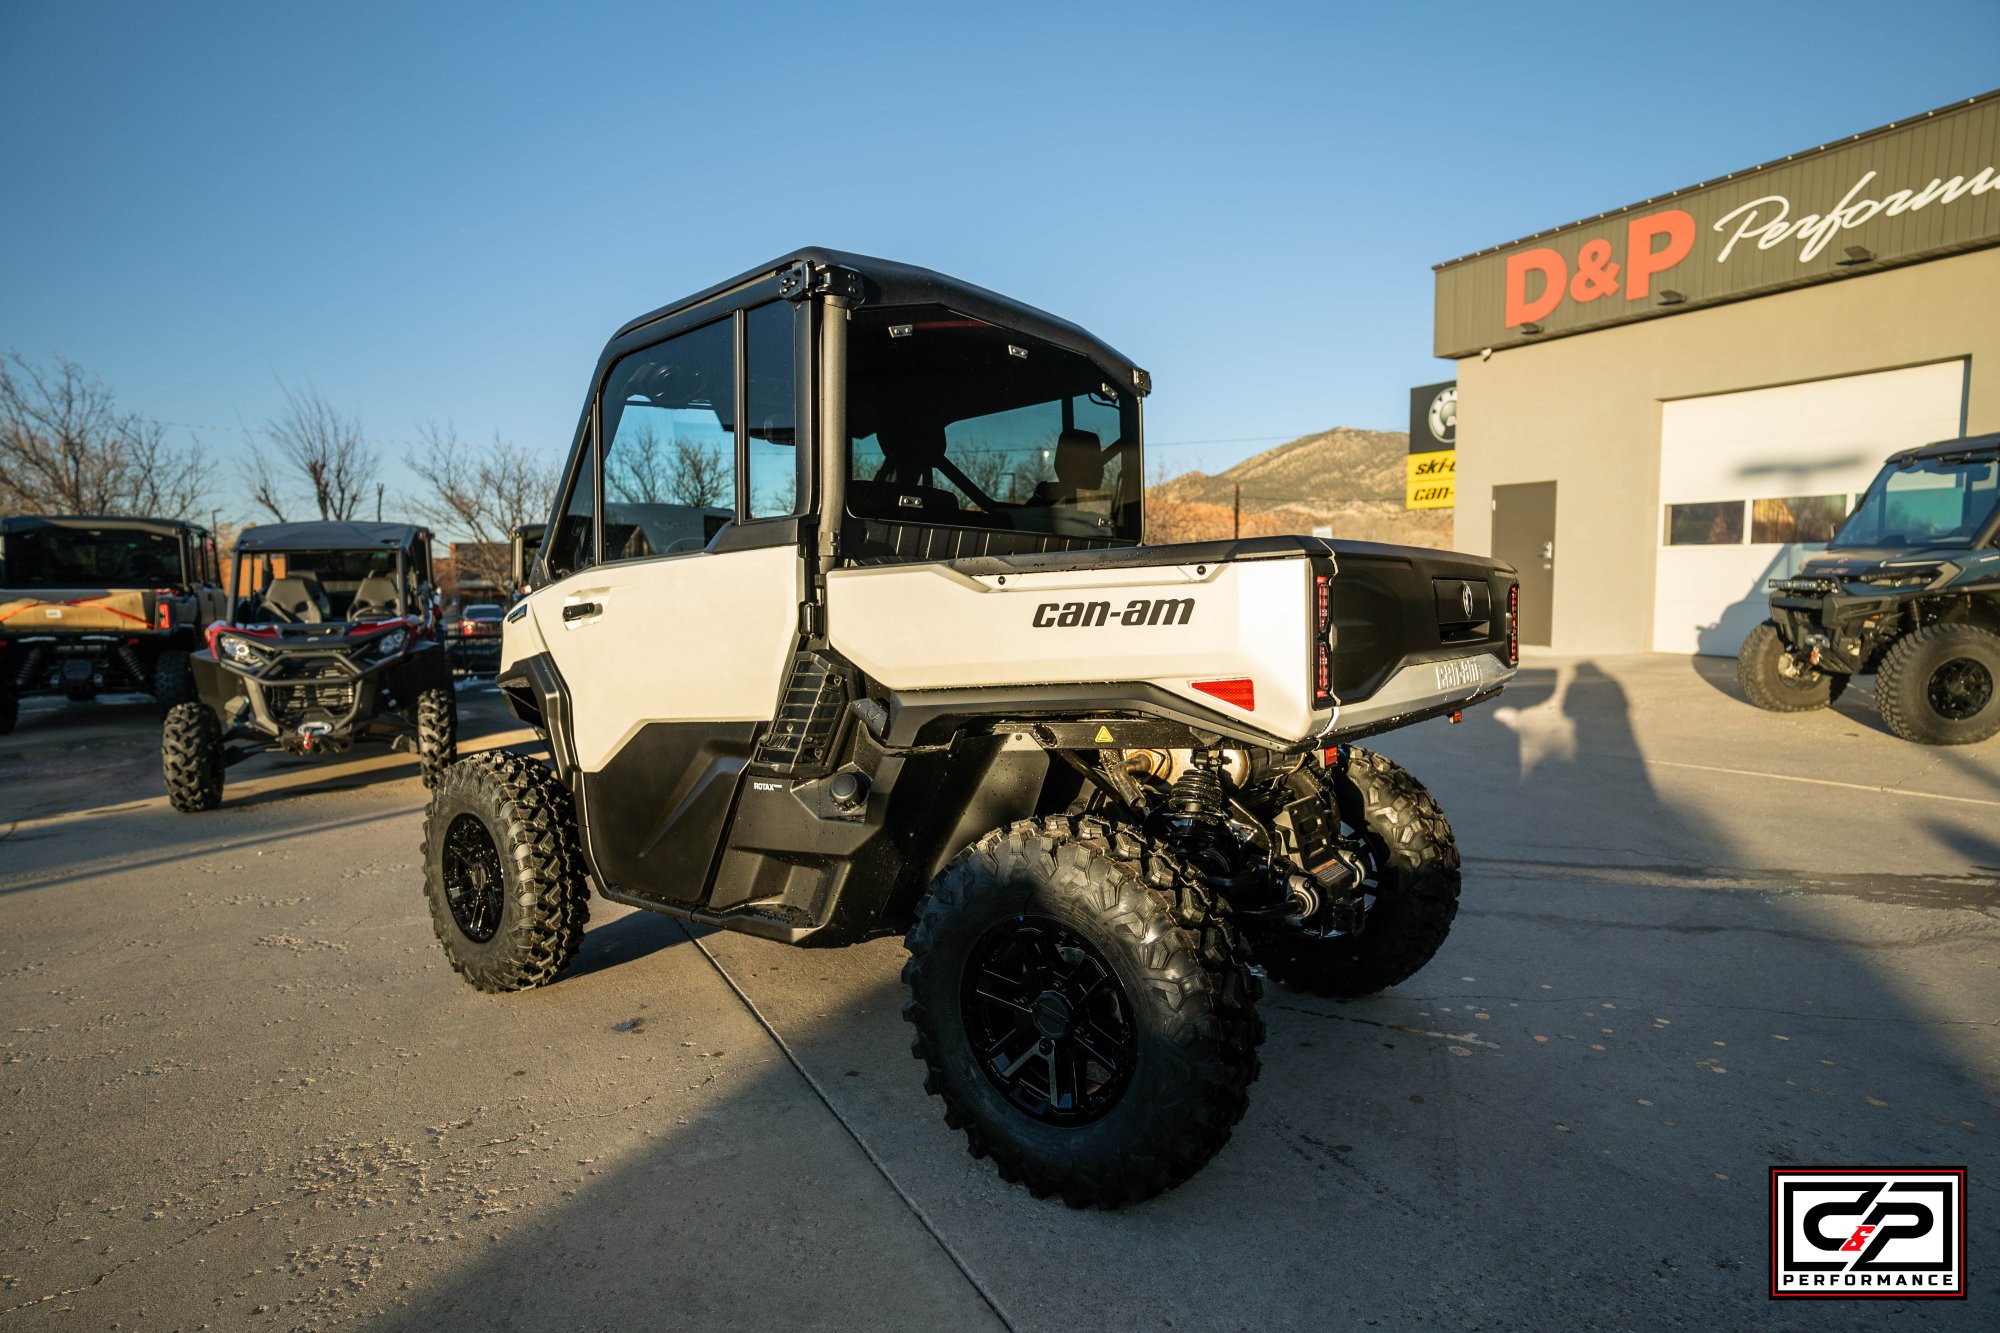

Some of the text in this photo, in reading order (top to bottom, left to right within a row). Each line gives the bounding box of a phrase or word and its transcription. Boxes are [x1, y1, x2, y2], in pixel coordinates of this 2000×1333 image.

[1505, 166, 2000, 328] D&P Perform
[1032, 597, 1196, 628] can-am
[753, 782, 775, 791] ROTAX
